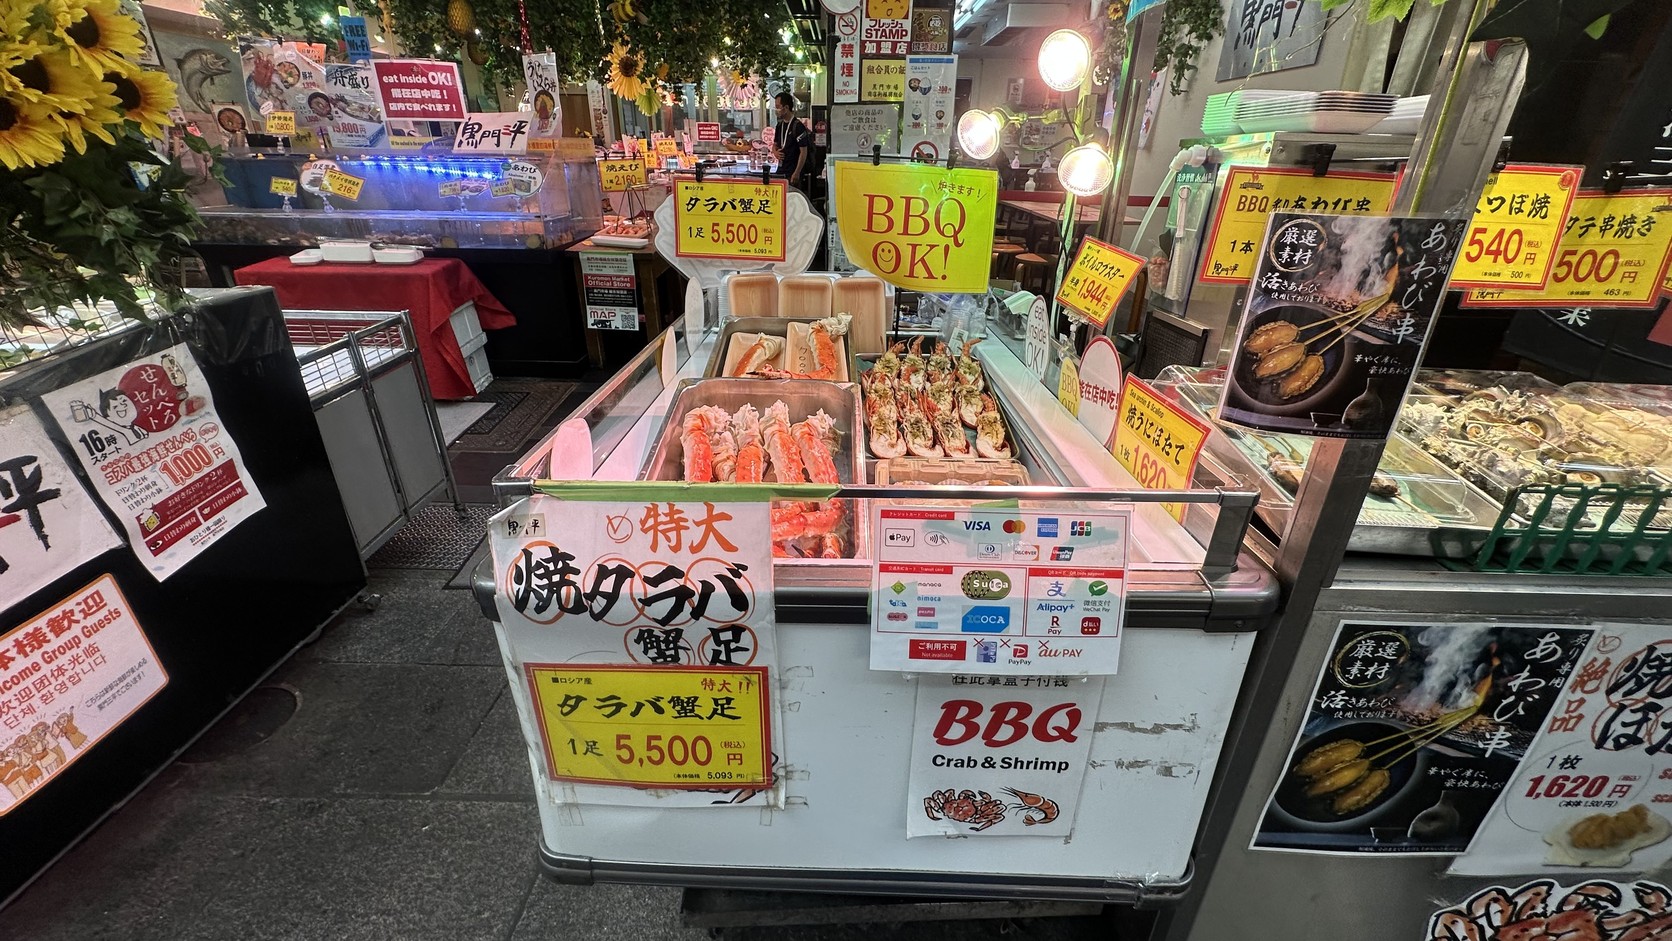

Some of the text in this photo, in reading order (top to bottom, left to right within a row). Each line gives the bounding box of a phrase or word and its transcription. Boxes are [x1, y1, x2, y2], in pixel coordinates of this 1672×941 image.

[343, 24, 367, 38] FREE
[868, 19, 904, 29] フレッシュ
[865, 28, 909, 40] STAMP
[864, 42, 908, 54] 加盟店
[840, 43, 855, 78] 禁煙
[332, 69, 370, 89] 舟盛り
[382, 71, 453, 86] eat inside OK!
[871, 83, 899, 91] 黒門市場
[852, 116, 877, 124] ご飲食は
[511, 163, 537, 174] あわび
[604, 163, 640, 173] 焼えび
[337, 183, 352, 194] 216
[614, 174, 637, 186] 2,160
[685, 196, 774, 215] タラバ蟹足
[1236, 196, 1268, 213] BBQ
[861, 193, 967, 249] BBQ
[688, 226, 705, 239] 1足
[711, 222, 758, 246] 5,500
[764, 236, 773, 246] 円
[1279, 227, 1319, 246] 厳選
[1230, 239, 1255, 254] 1本
[1465, 227, 1543, 264] 540 (税込)
[872, 241, 950, 281] OK!
[1277, 248, 1313, 265] 素材
[1523, 252, 1536, 266] 円
[1552, 249, 1620, 283] 500
[1261, 272, 1321, 293] 活きあわび
[1392, 222, 1448, 344] あわび串
[1510, 270, 1523, 279] 500
[1620, 270, 1638, 283] 円
[1077, 276, 1108, 306] 1,944
[1604, 288, 1620, 296] 463
[589, 310, 617, 319] MAP
[1034, 304, 1044, 323] eat
[1029, 322, 1047, 345] inside
[1026, 342, 1045, 375] OK!
[140, 366, 177, 425] せんべろ
[1061, 372, 1079, 402] BBQ
[134, 390, 158, 430] セット
[79, 429, 118, 457] 16時
[1126, 403, 1186, 466] 焼うにほたて
[90, 446, 122, 465] スタート
[1120, 443, 1130, 463] 1枚
[159, 442, 213, 487] 1,000
[213, 447, 226, 459] 円
[115, 475, 148, 497] ドリンク2杯
[122, 482, 159, 504] 日替わり刺身
[167, 468, 223, 508] お好きなドリンク2杯
[638, 502, 739, 554] 特大
[962, 520, 991, 531] VISA
[896, 533, 911, 543] Pay
[513, 546, 750, 627] 焼タラバ
[973, 579, 1009, 589] Suica
[917, 594, 942, 602] nimoca
[1036, 603, 1075, 613] Alipay+
[967, 614, 1006, 624] ICOCA
[1051, 616, 1060, 626] R
[41, 607, 122, 665] Group Guests
[1048, 628, 1062, 636] Pay
[633, 626, 750, 665] 蟹足
[918, 642, 957, 651] ご利用不可
[1038, 648, 1083, 658] au PAY
[1349, 640, 1400, 660] 厳選
[0, 641, 101, 718] 欢迎团体光临
[1345, 661, 1391, 680] 素材
[560, 677, 593, 685] ロシア産
[3, 654, 107, 730] 단체 환영합니다
[1320, 690, 1396, 709] 活きあわび
[1478, 631, 1562, 758] あわび串
[1548, 656, 1611, 734] 絶品
[557, 694, 742, 721] タラバ蟹足
[932, 699, 1082, 748] BBQ
[567, 734, 746, 768] 1足 5,500 (税込)
[727, 754, 744, 766] 円
[931, 754, 1070, 774] Crab & Shrimp
[1546, 755, 1583, 770] 1枚
[1525, 775, 1632, 799] 1,620 円
